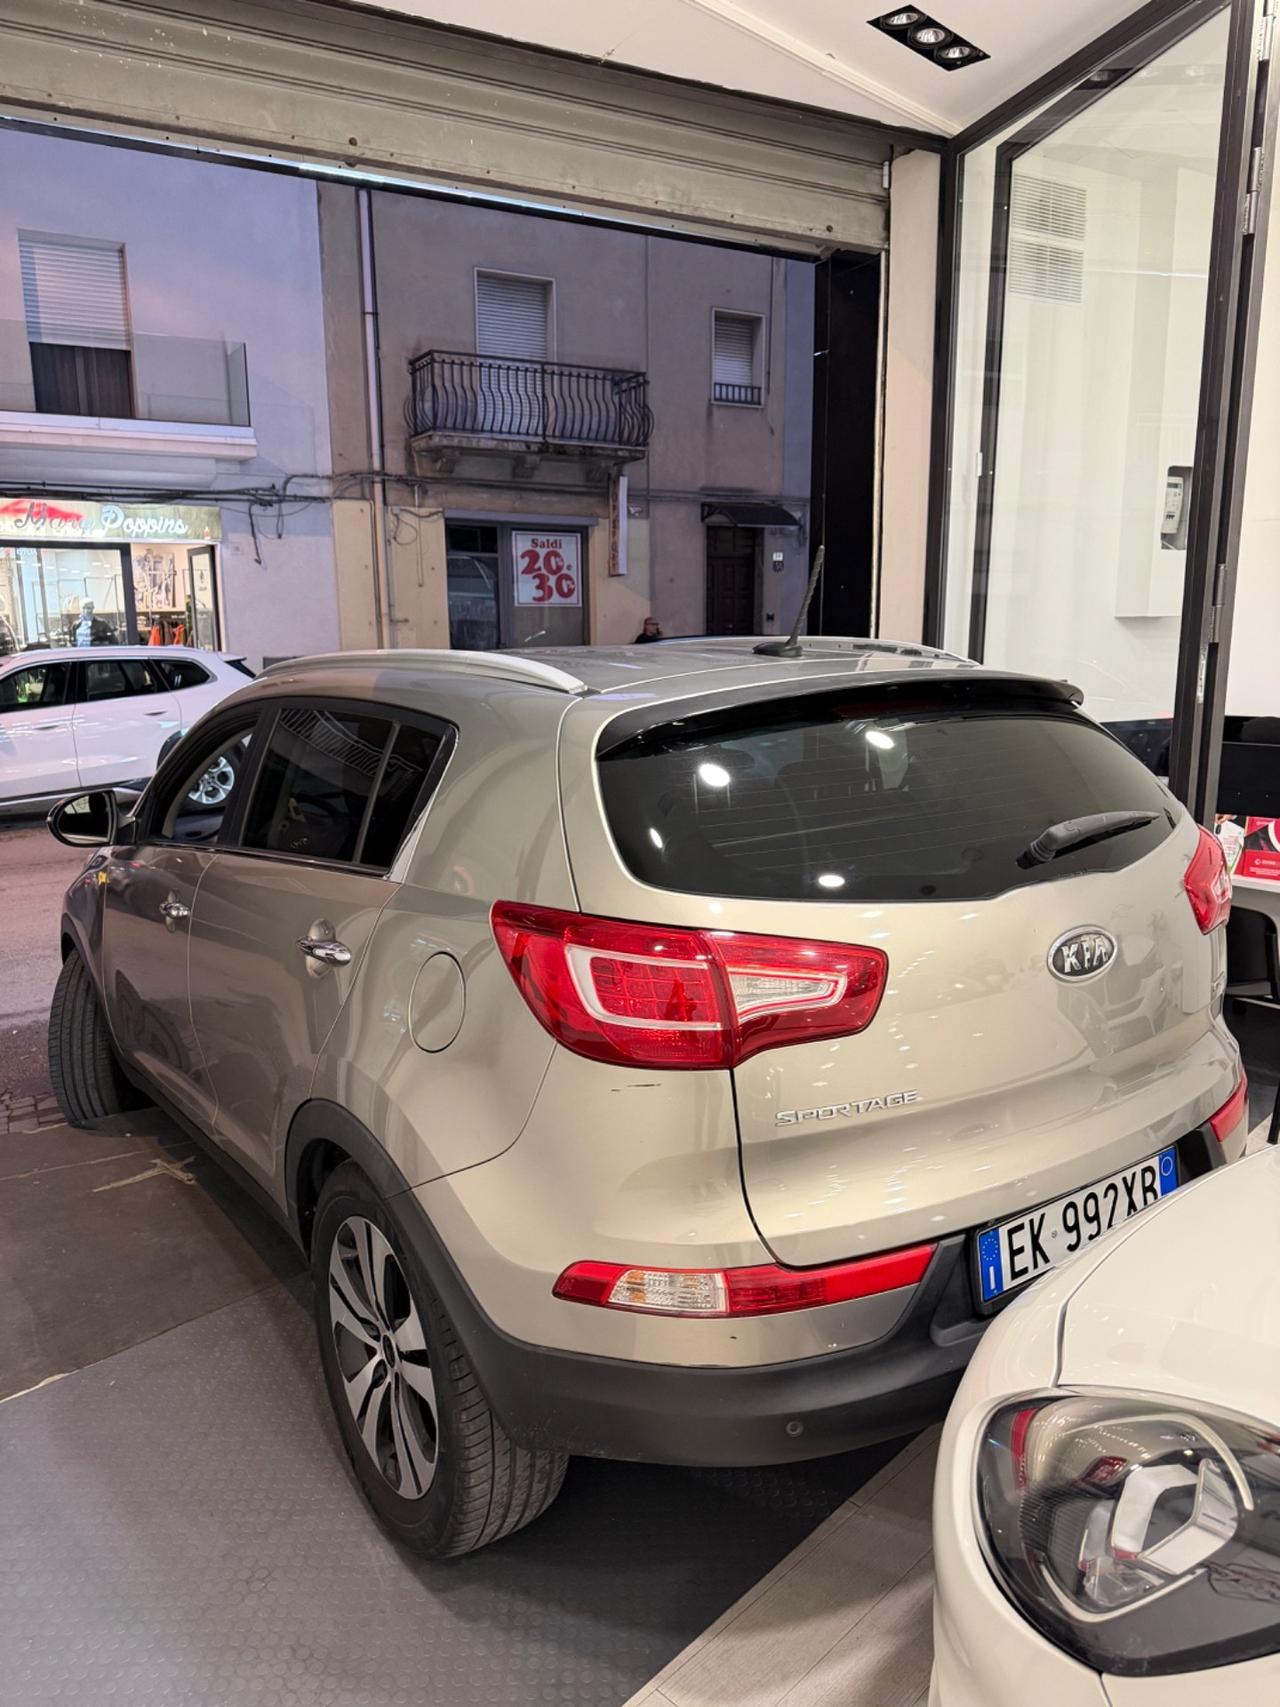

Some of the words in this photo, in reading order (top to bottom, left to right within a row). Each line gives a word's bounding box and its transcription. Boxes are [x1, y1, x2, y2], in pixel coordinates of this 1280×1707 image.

[101, 505, 188, 538] Poppins
[530, 538, 563, 549] Saldi
[1061, 936, 1109, 974] KIA
[774, 1089, 922, 1127] SPORTAGE
[1007, 1212, 1050, 1281] EK
